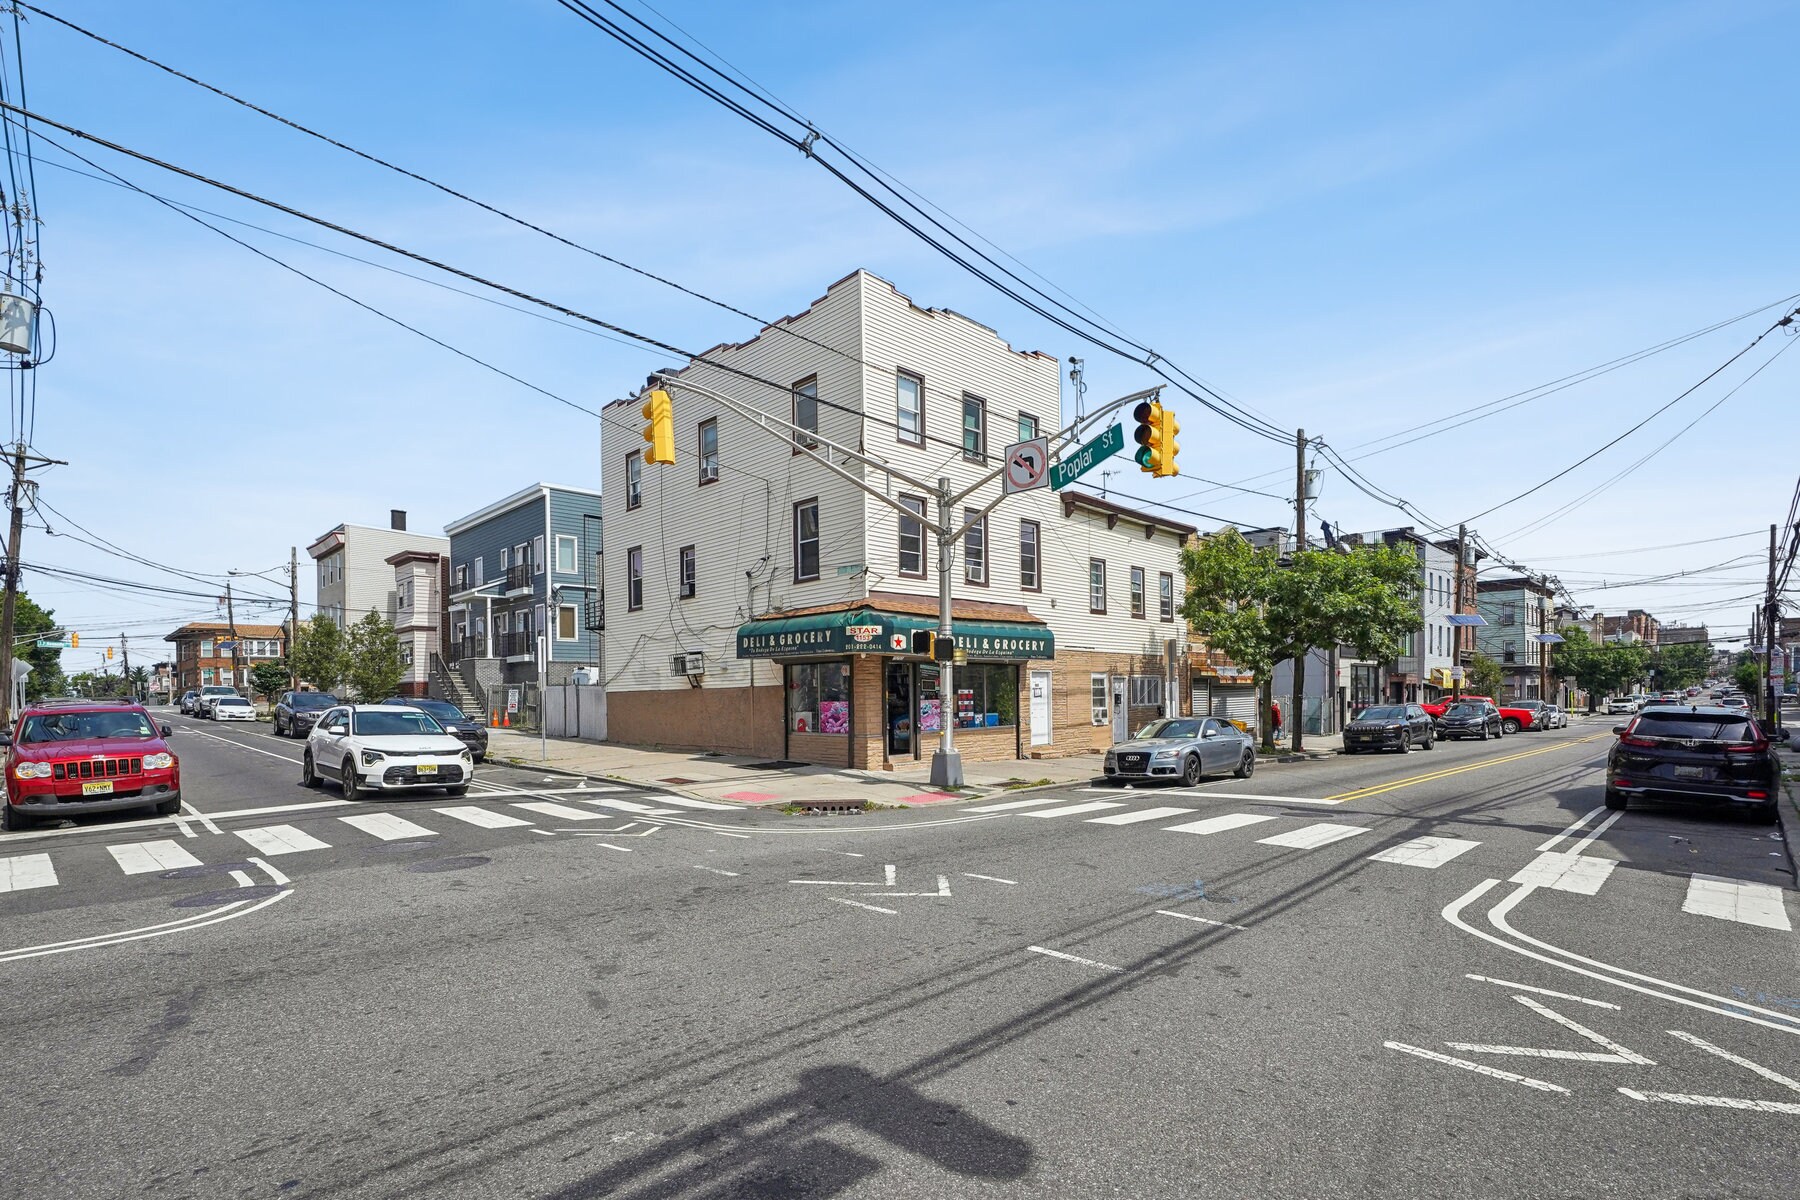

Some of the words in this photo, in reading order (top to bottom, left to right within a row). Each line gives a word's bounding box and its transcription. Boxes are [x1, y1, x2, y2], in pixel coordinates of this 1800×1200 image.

[1059, 447, 1093, 482] Poplar
[1102, 431, 1114, 449] St
[743, 636, 765, 648] DELI
[769, 635, 775, 646] &
[780, 630, 831, 646] GROCERY
[982, 638, 989, 649] &
[994, 638, 1045, 651] GROCERY
